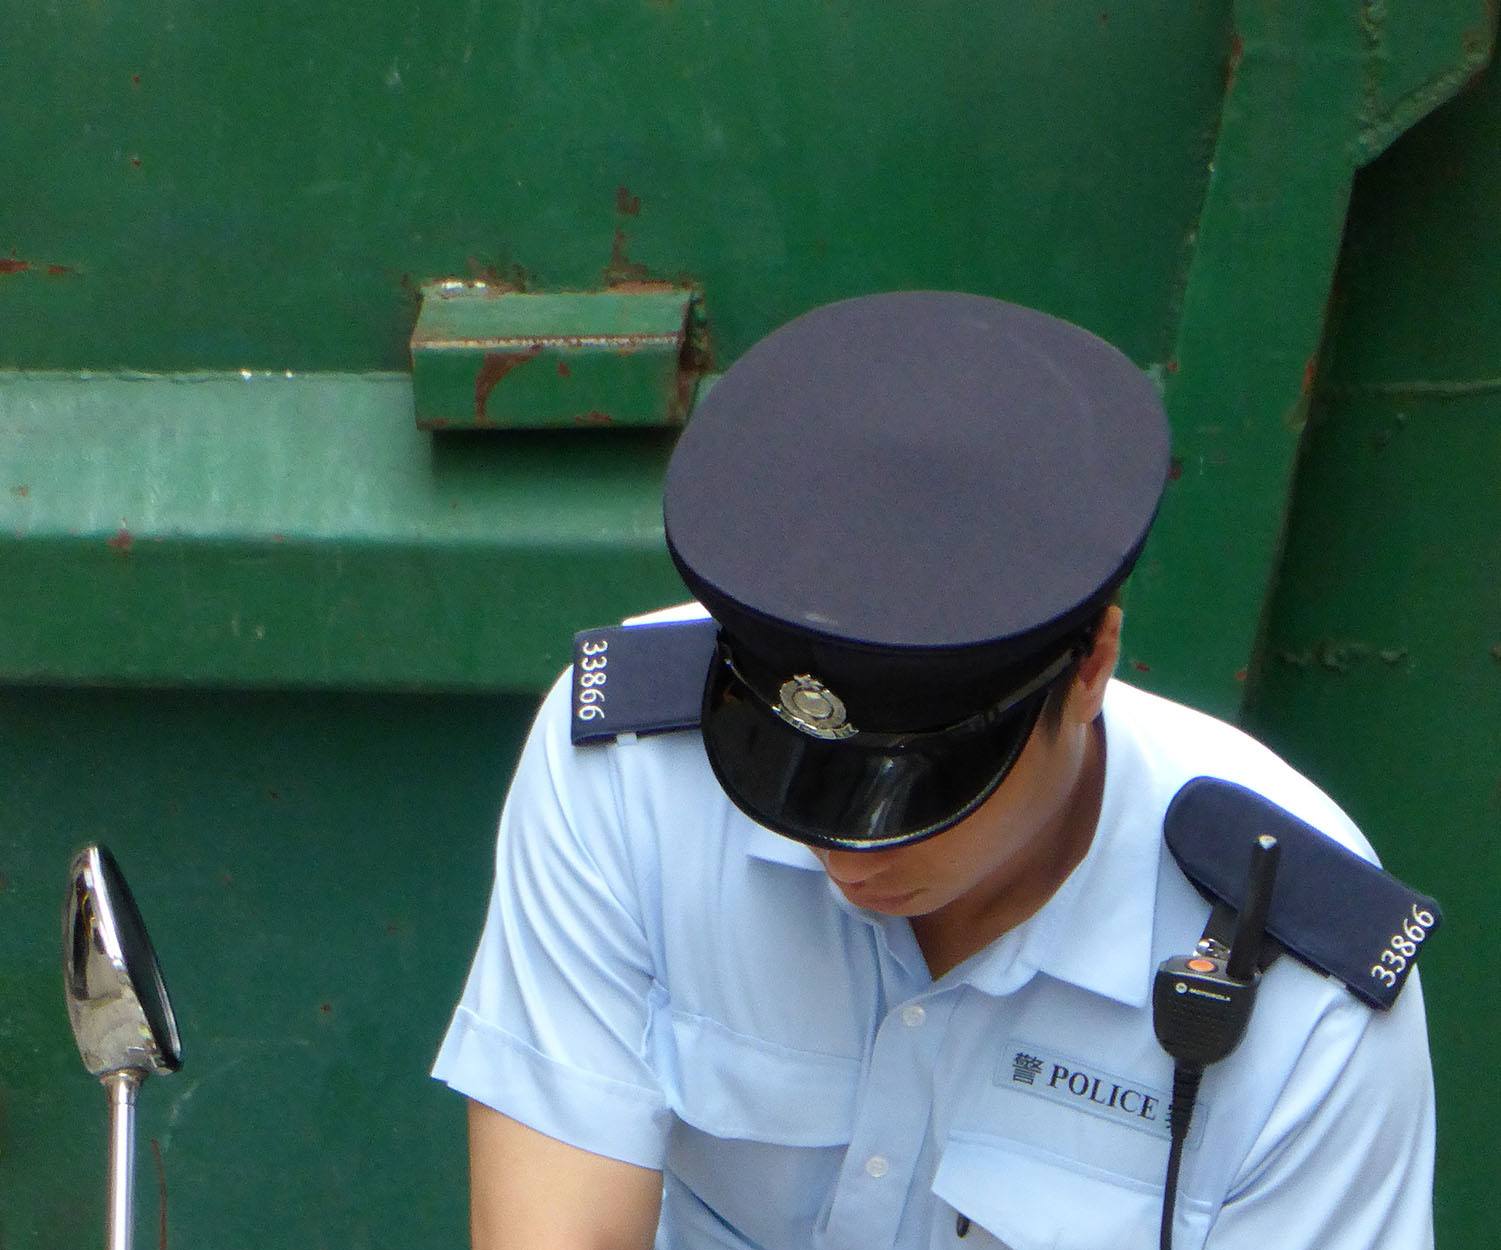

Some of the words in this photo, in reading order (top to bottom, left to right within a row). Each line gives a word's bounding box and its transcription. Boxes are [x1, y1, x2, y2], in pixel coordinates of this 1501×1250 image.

[578, 640, 608, 720] 33866
[1371, 903, 1435, 988] 33866
[1012, 1052, 1045, 1086] 警
[1048, 1063, 1160, 1121] POLICE
